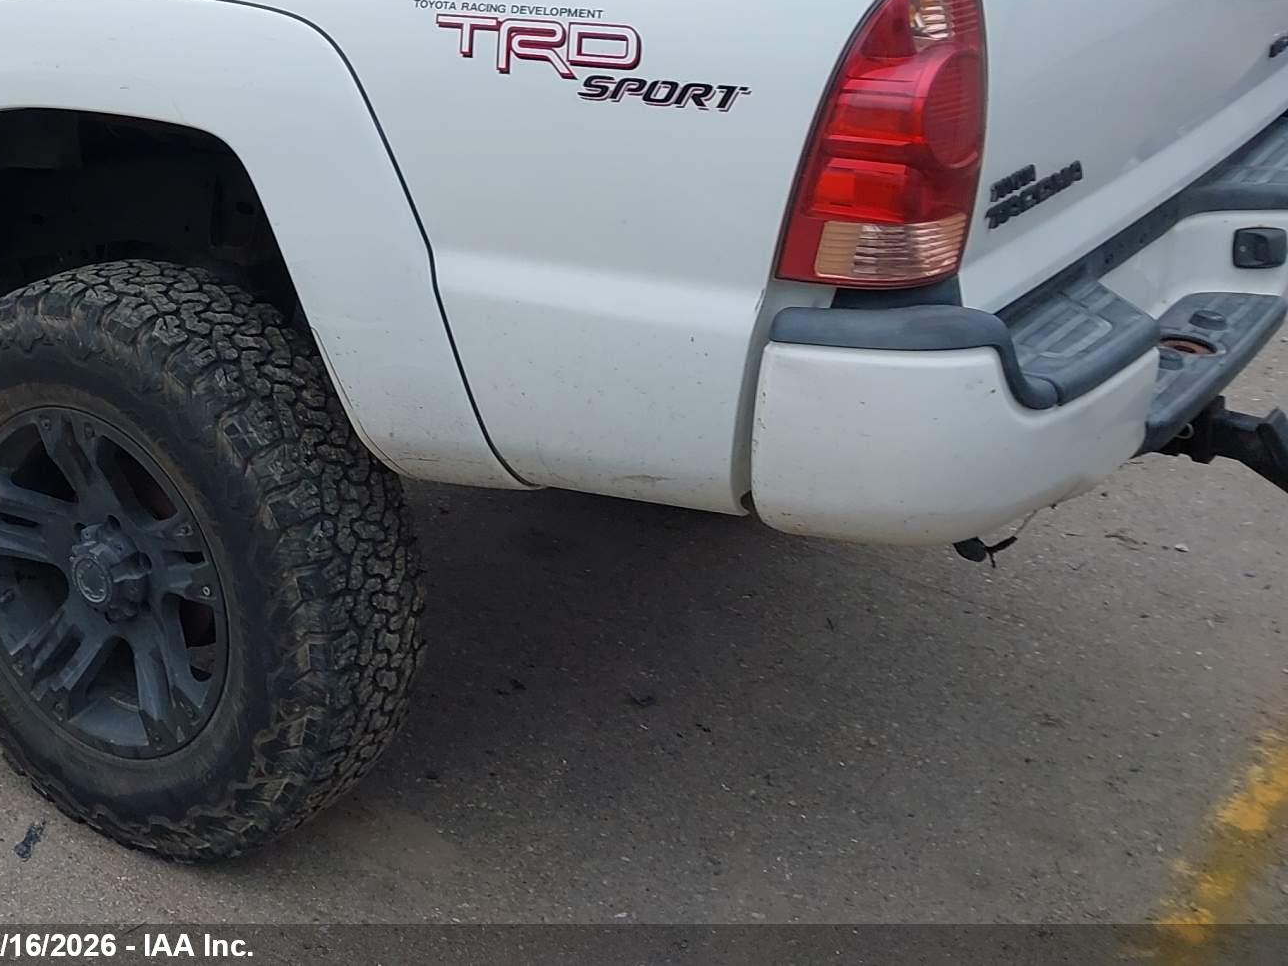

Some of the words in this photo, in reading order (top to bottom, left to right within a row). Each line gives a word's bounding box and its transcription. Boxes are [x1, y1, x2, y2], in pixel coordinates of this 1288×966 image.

[414, 0, 457, 11] TOYOTA
[461, 2, 507, 14] RACING
[511, 5, 604, 19] DEVELOPMENT
[436, 13, 642, 80] TRD
[577, 74, 752, 113] SPORT
